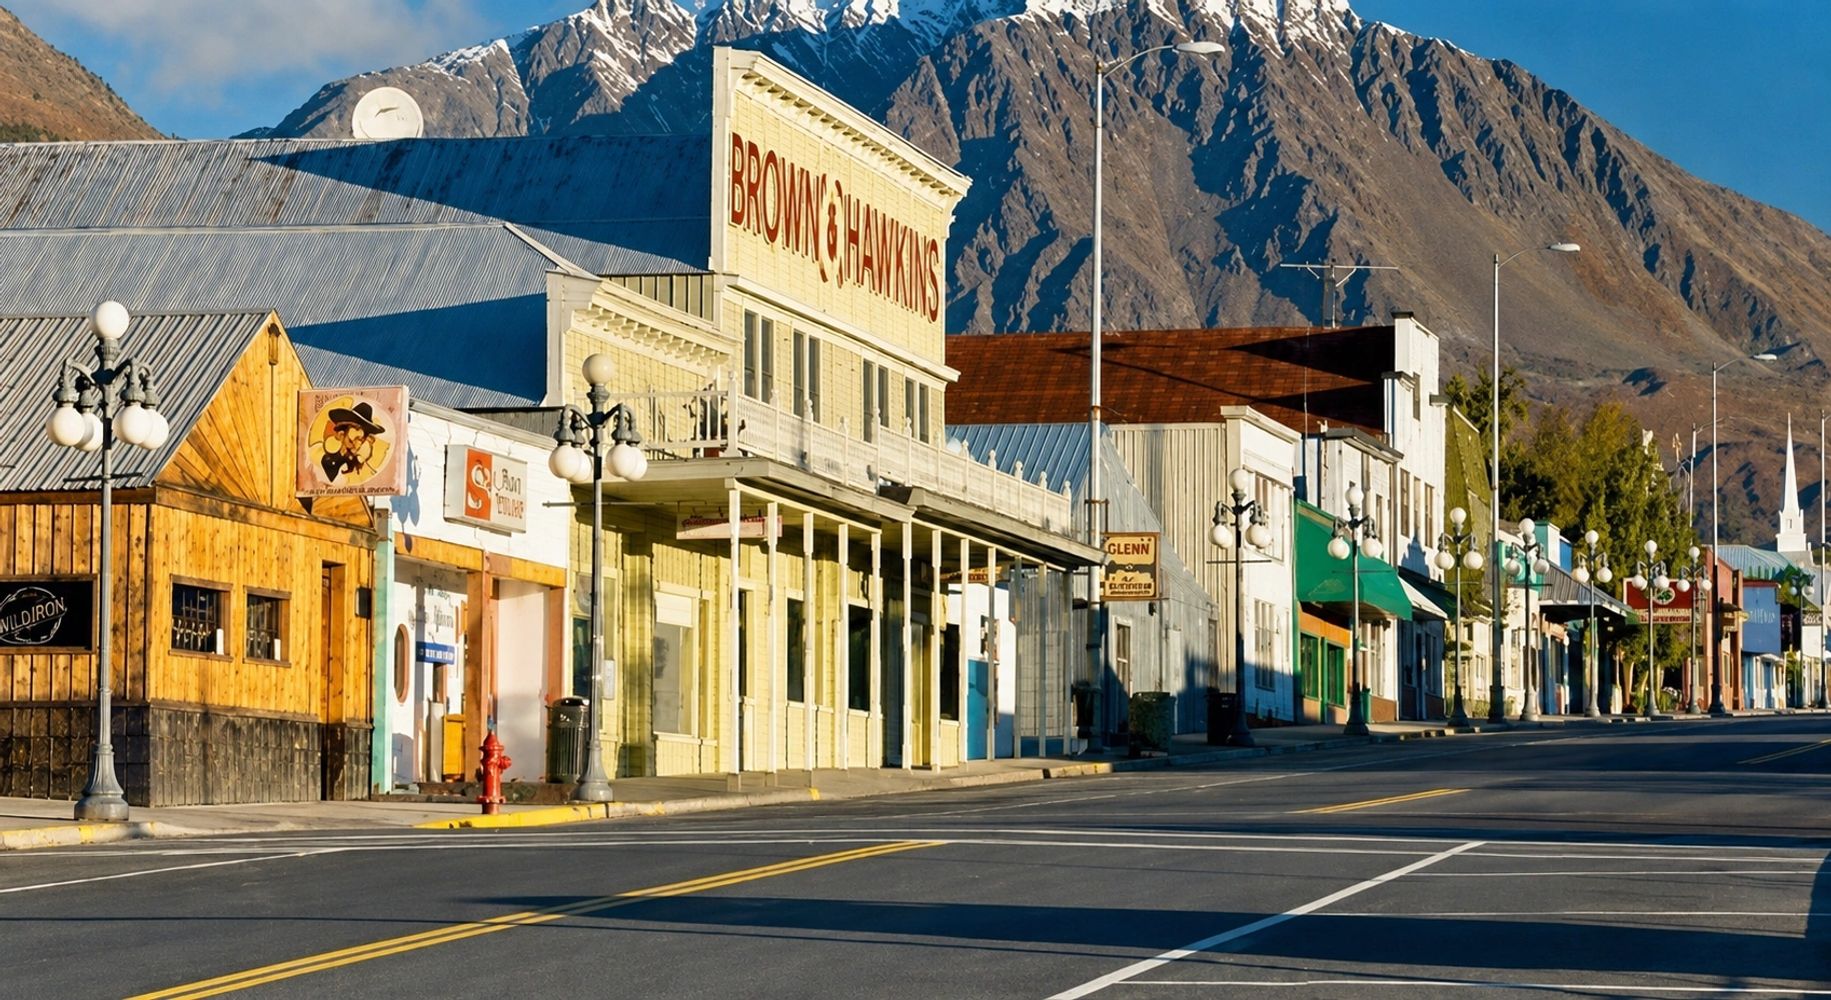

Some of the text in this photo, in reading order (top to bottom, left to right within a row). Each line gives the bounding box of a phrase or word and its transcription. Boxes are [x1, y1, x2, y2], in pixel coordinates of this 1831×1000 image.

[729, 131, 820, 263] BROWN
[843, 193, 940, 324] HAWKINS
[1107, 542, 1150, 556] GLENN
